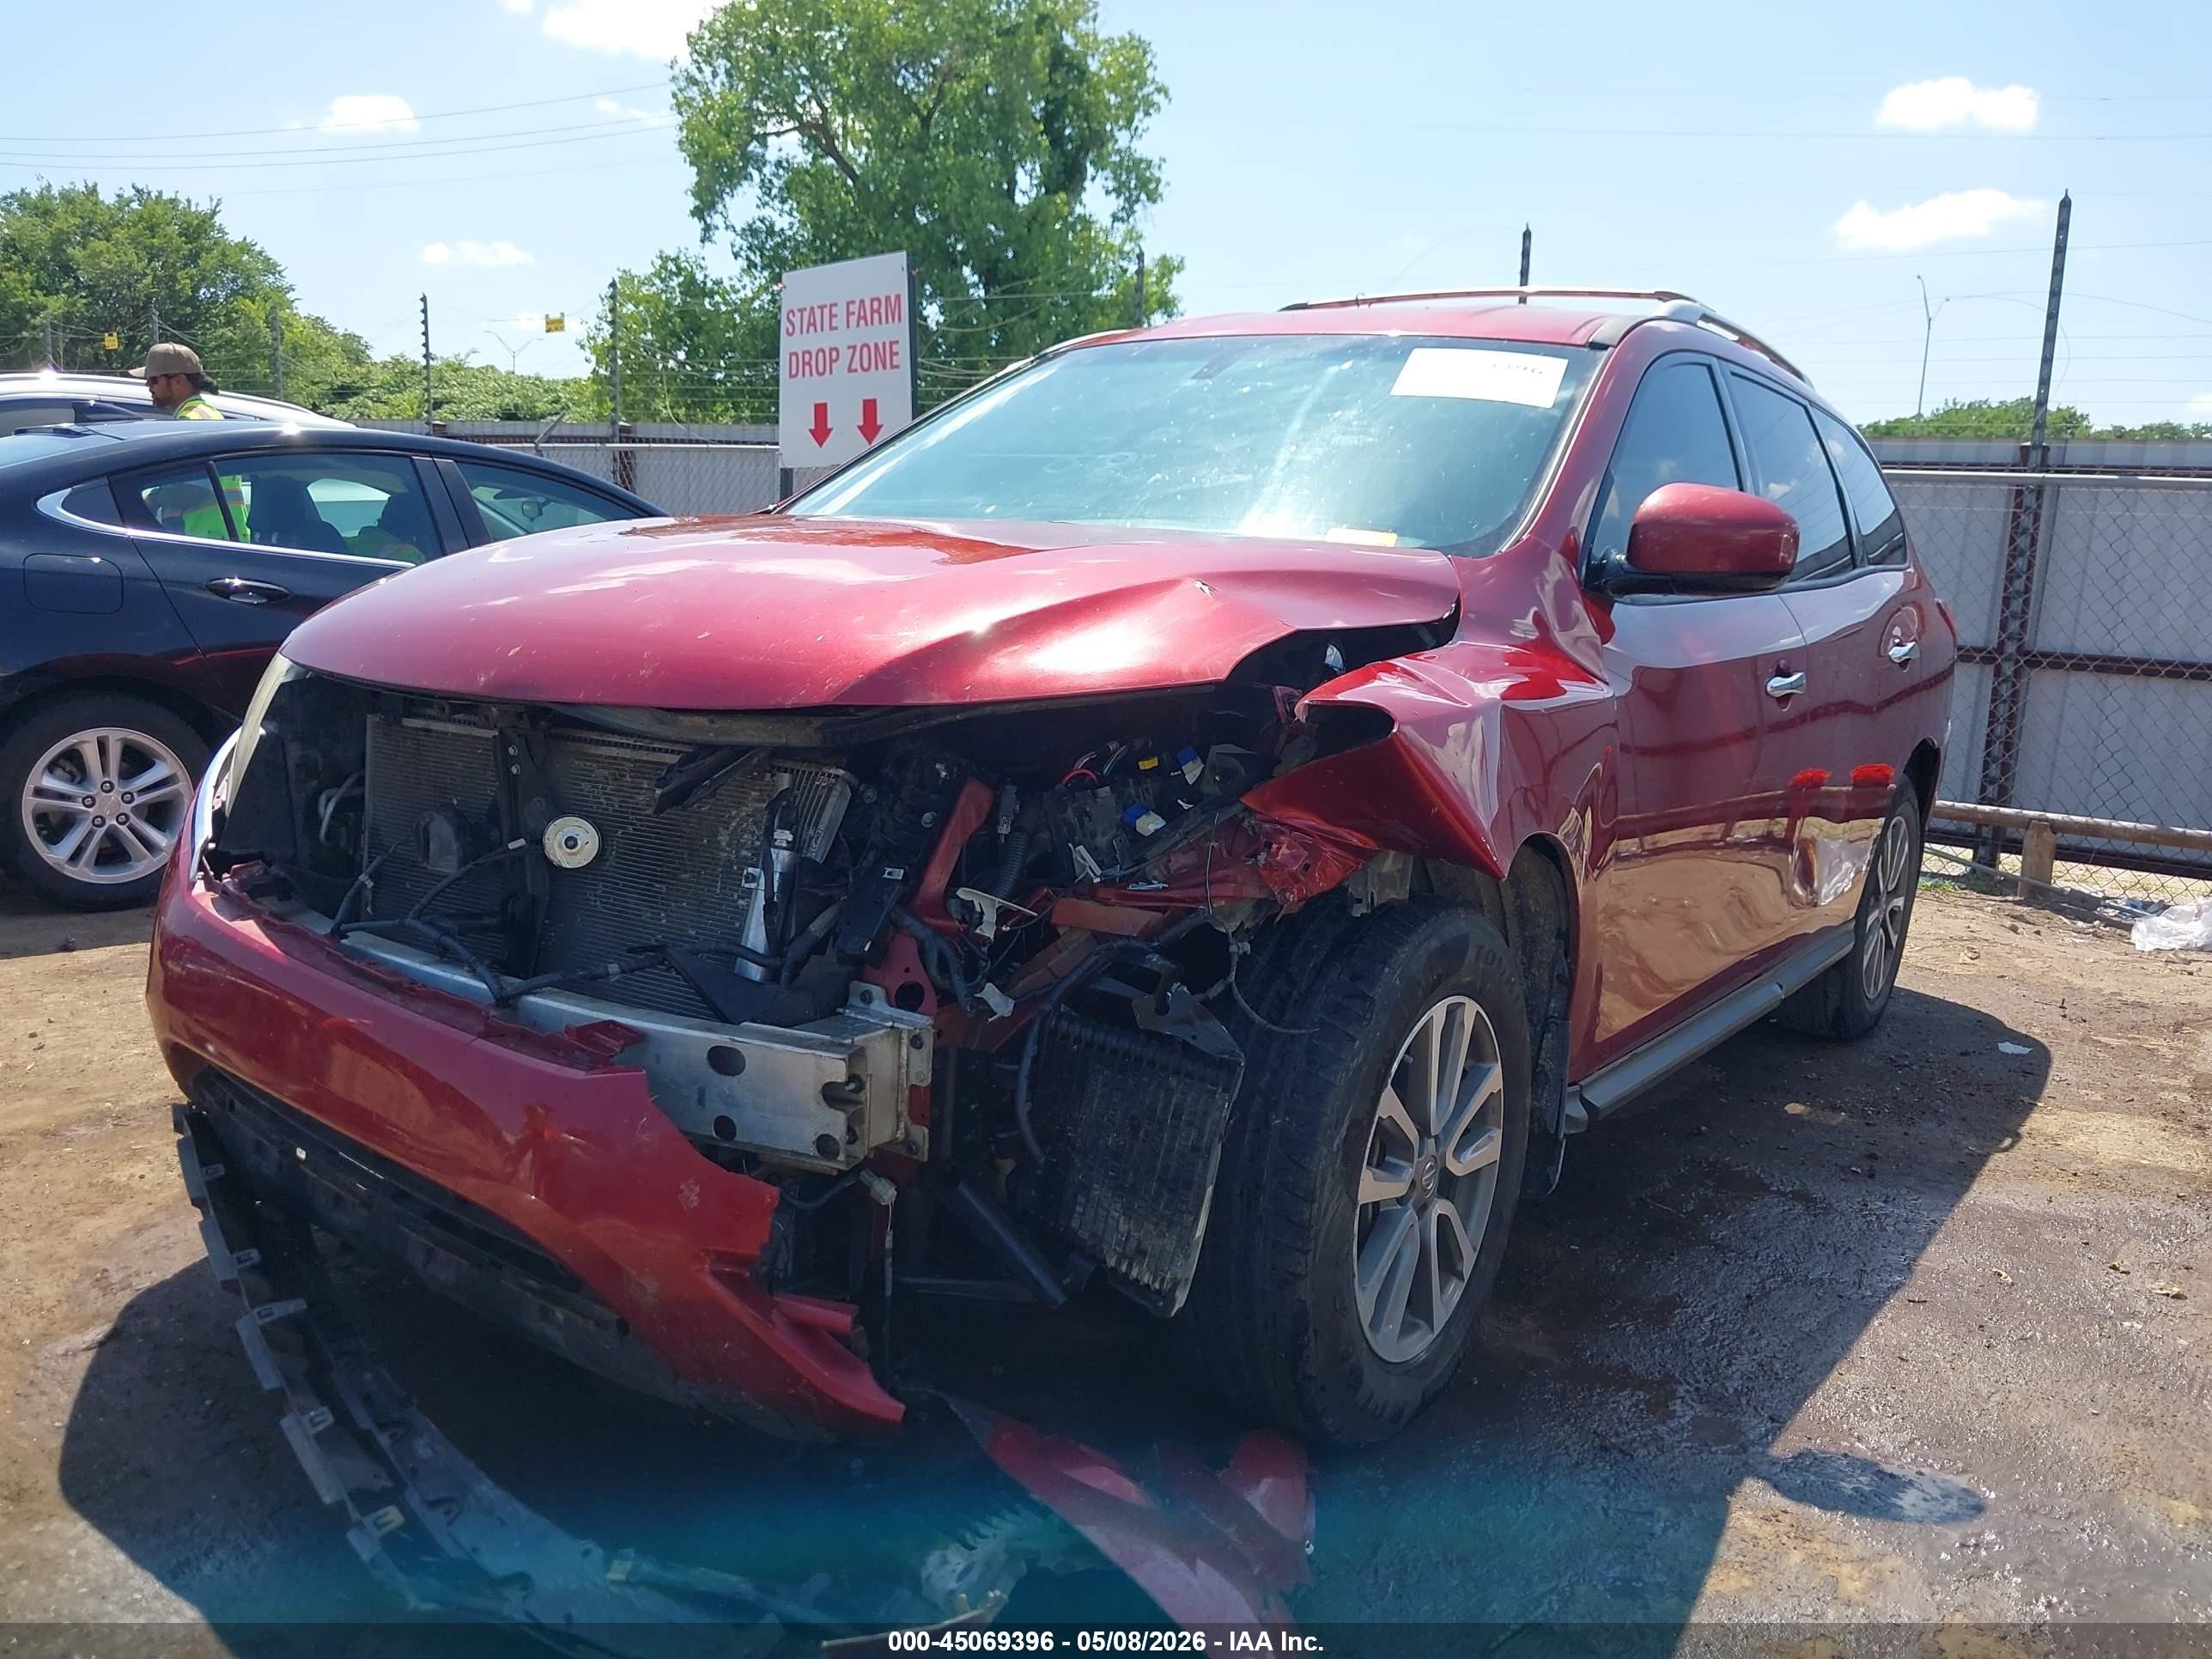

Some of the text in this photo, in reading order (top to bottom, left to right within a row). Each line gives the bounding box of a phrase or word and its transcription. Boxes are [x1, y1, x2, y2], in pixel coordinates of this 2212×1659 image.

[786, 294, 902, 337] STATE FARM
[788, 340, 900, 379] DROP ZONE
